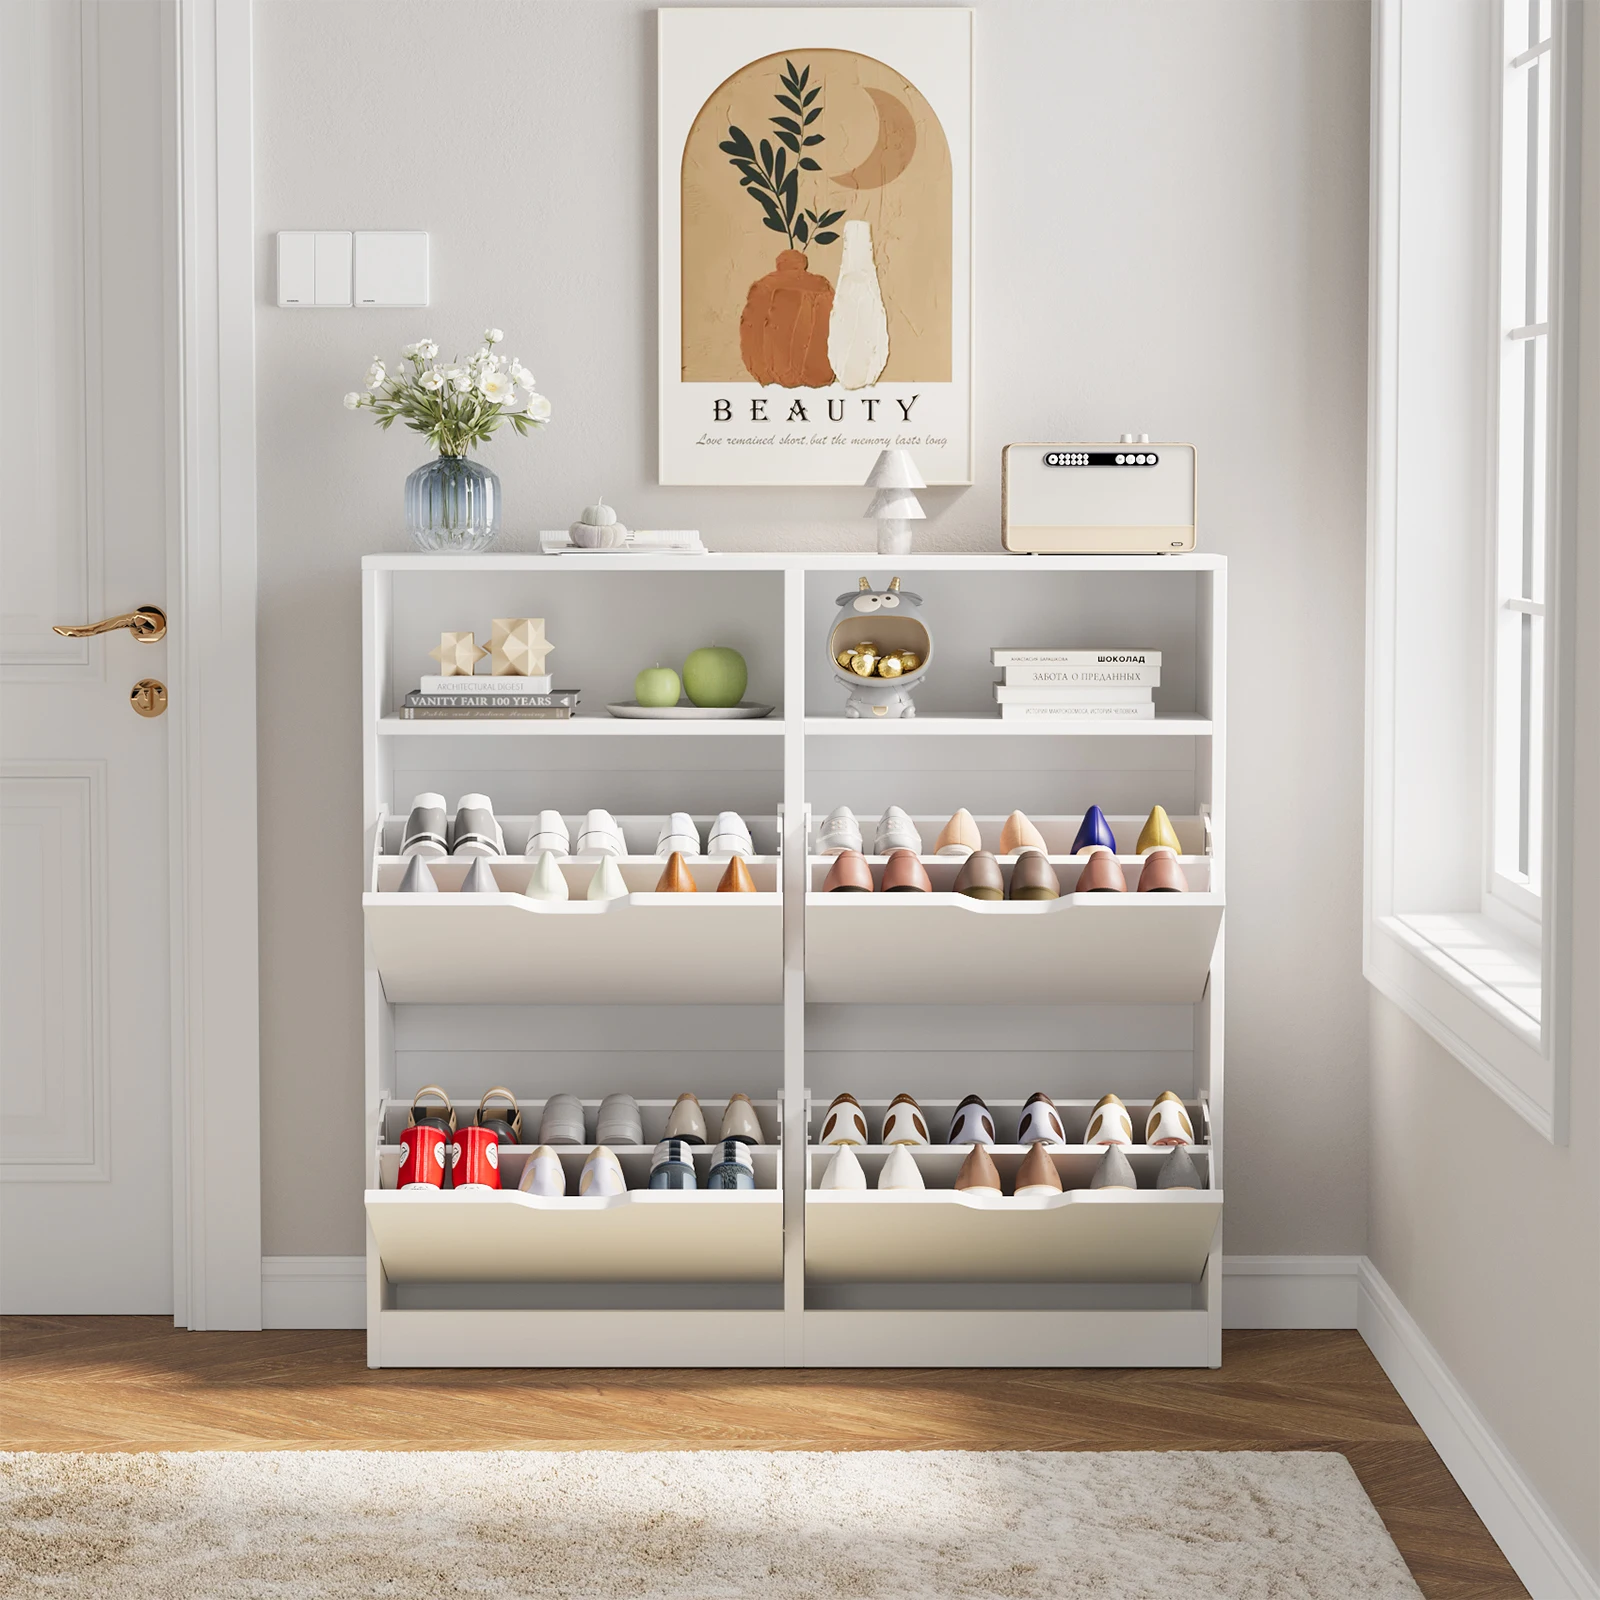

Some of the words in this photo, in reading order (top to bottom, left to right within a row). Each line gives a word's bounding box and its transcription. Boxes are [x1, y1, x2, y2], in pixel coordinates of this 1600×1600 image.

[713, 394, 921, 422] BEAUTY
[696, 433, 722, 446] Love
[727, 434, 775, 446] remained
[831, 434, 846, 446] the
[851, 437, 891, 449] memory
[895, 434, 921, 446] lasts
[925, 435, 948, 449] long
[1097, 656, 1146, 664] ШОКОЛАД
[1033, 673, 1068, 681] ЗАБОТА
[1081, 673, 1141, 682] ПРЕДАННЫХ
[437, 683, 497, 691] ARCHITECTURAL
[498, 683, 524, 691] DIGEST
[411, 697, 458, 706] VANITY
[461, 697, 488, 706] FAIR
[491, 697, 510, 706] 100
[513, 697, 552, 706] YEARS
